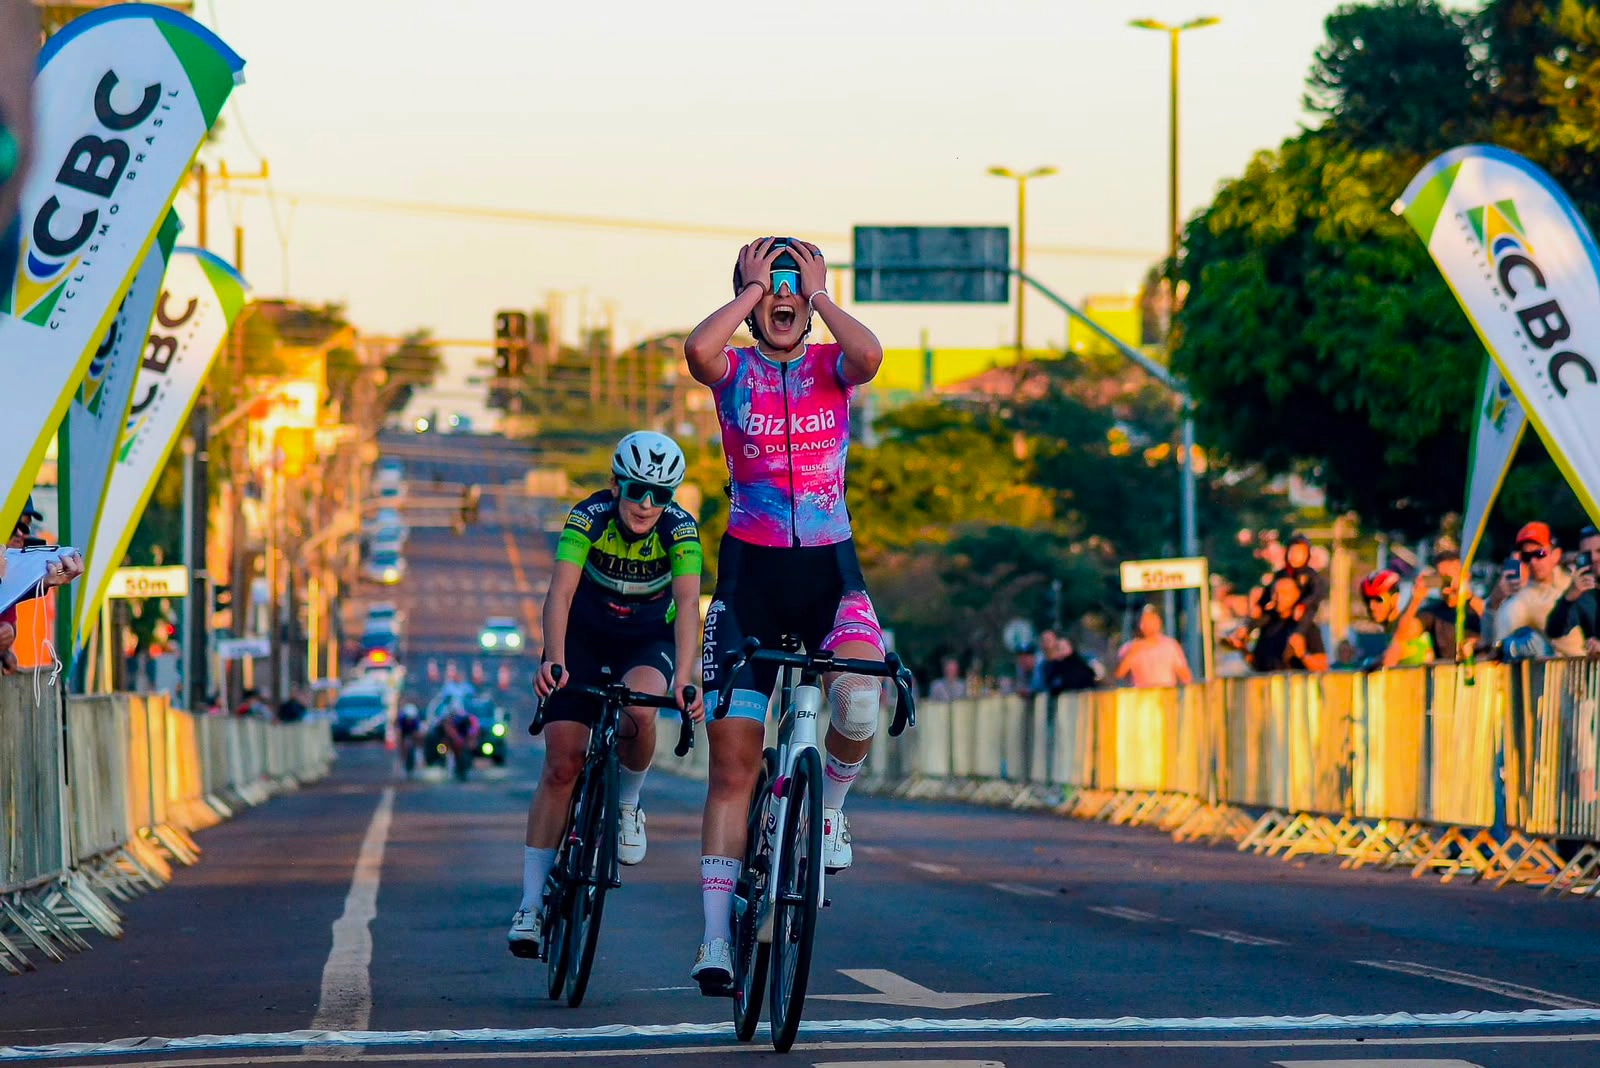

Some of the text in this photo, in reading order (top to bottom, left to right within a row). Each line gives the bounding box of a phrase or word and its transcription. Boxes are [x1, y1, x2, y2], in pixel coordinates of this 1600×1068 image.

[33, 69, 162, 258] CBC
[50, 204, 119, 330] CICLISMO
[127, 89, 179, 181] BRASIL
[1497, 254, 1598, 399] CBC
[747, 408, 836, 435] Bizkaia
[765, 438, 836, 453] DURANGO
[645, 463, 663, 479] 21
[126, 578, 168, 592] 50m
[703, 613, 719, 682] Bizkaia
[797, 710, 816, 719] BH
